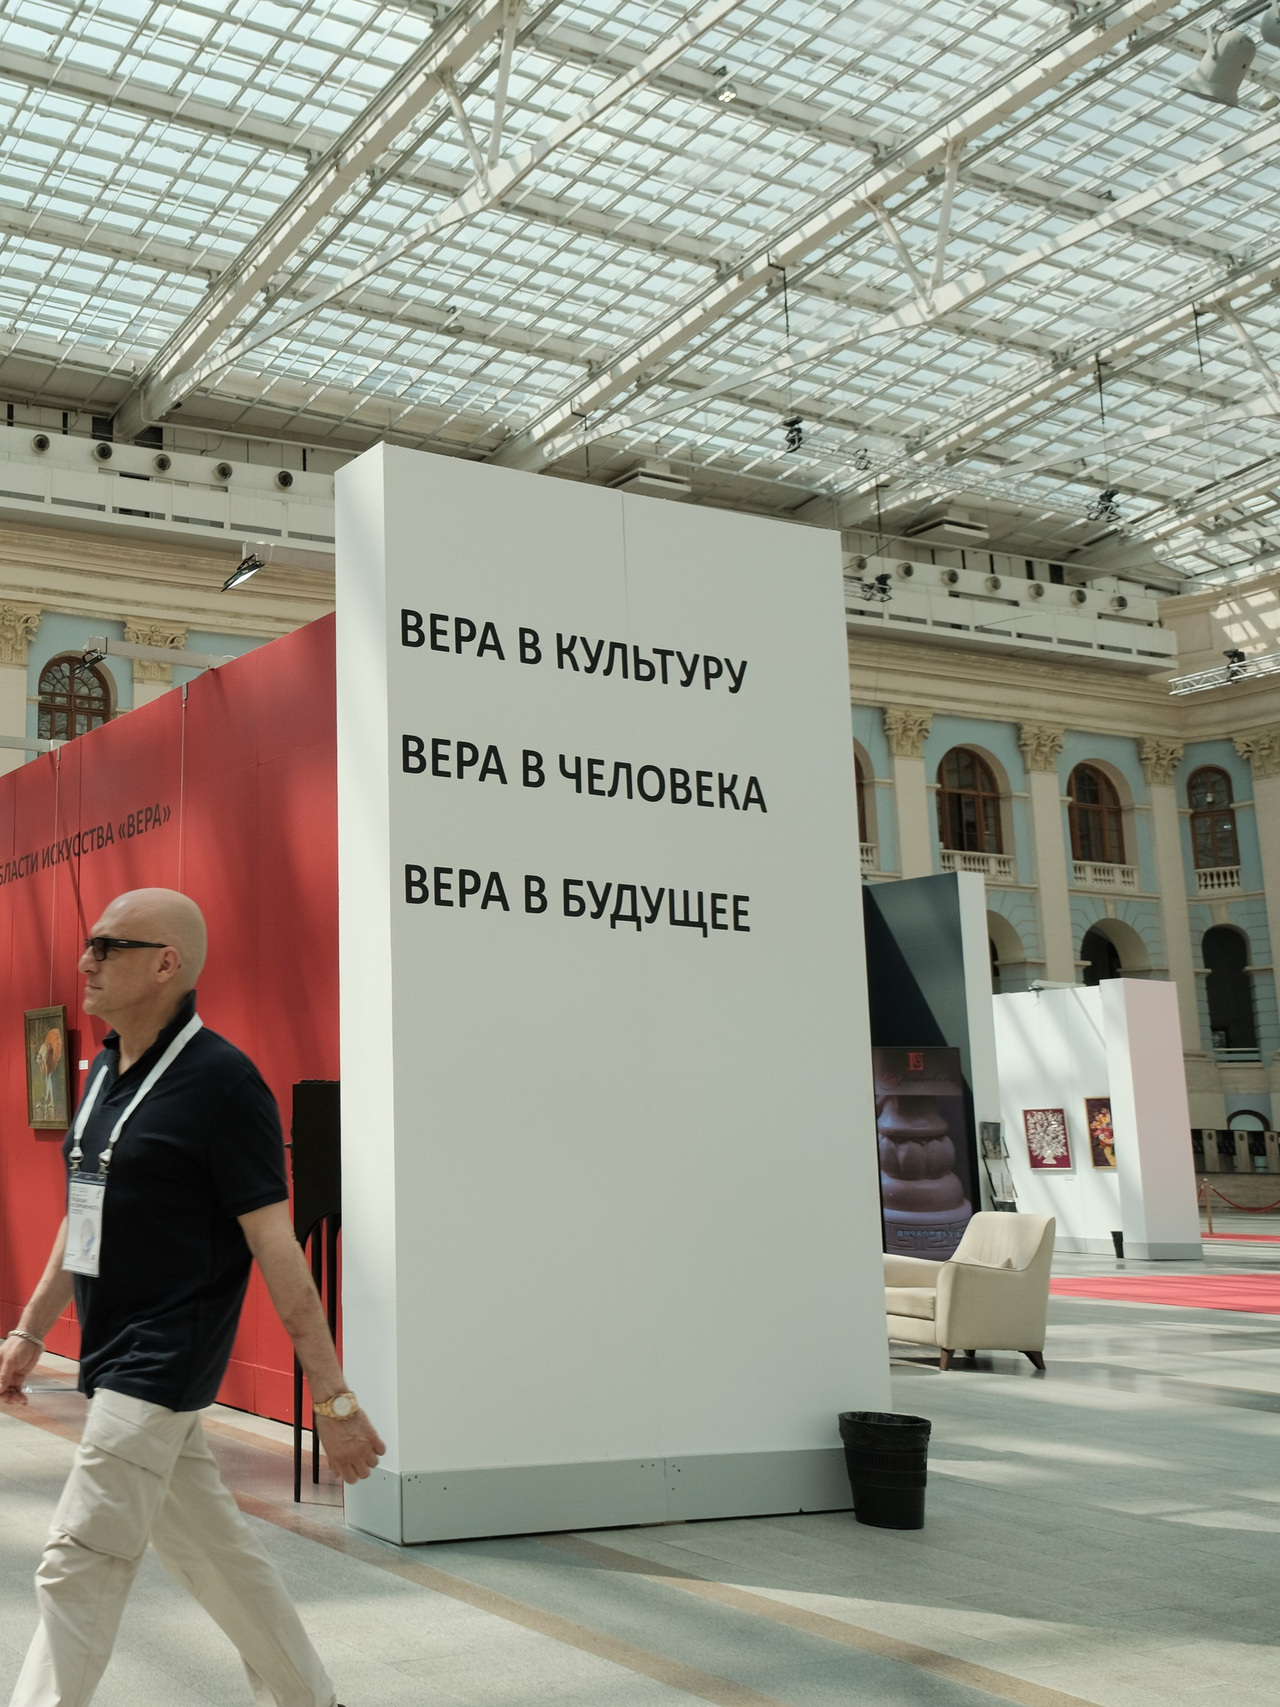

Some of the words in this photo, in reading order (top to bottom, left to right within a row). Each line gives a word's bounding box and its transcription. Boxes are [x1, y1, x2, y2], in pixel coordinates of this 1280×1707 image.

[400, 608, 506, 661] ВЕРА
[518, 626, 542, 665] В
[555, 632, 748, 694] КУЛЬТУРУ
[401, 734, 508, 785] ВЕРА
[522, 749, 546, 788] В
[558, 753, 768, 814] ЧЕЛОВЕКА
[42, 821, 115, 870] ИСКУССТВА
[118, 802, 172, 839] «ВЕРА»
[404, 863, 511, 912] ВЕРА
[524, 874, 548, 914] В
[562, 878, 751, 939] БУДУЩЕЕ
